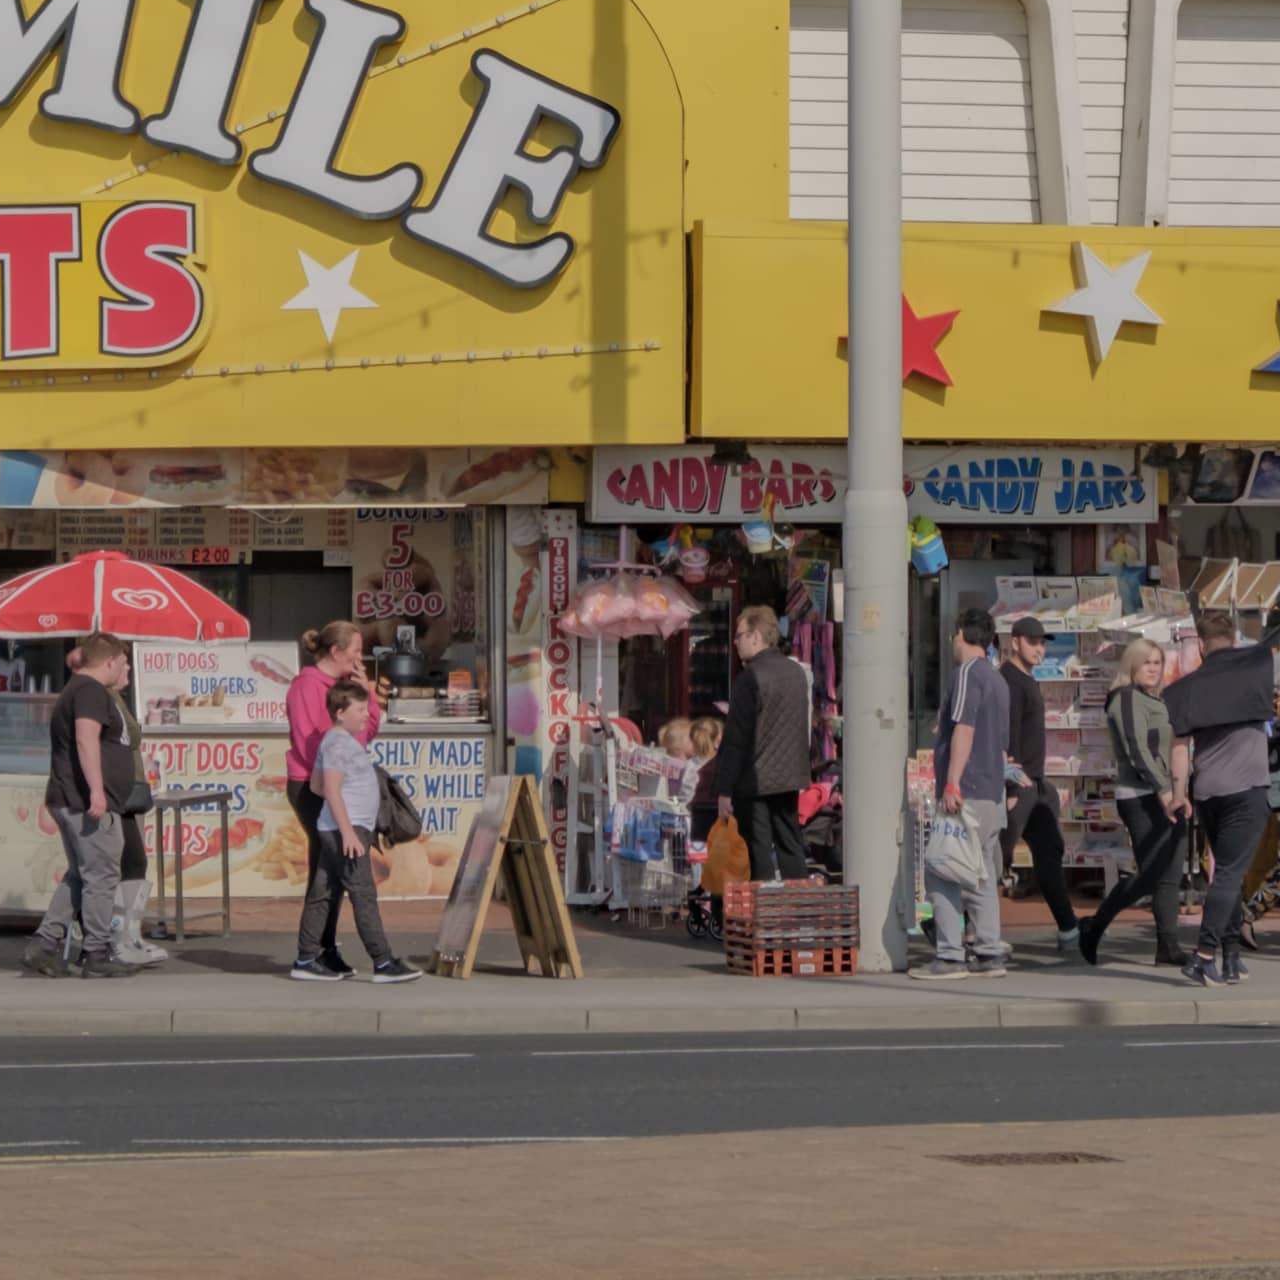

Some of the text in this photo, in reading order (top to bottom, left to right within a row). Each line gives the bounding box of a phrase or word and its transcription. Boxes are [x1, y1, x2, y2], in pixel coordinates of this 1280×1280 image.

[606, 457, 837, 514] CANDY BARS
[923, 457, 1146, 515] CANDY JARS
[132, 547, 185, 561] DRINKS
[384, 523, 415, 568] 5
[384, 570, 416, 591] FOR
[356, 592, 445, 618] £3.00
[143, 652, 218, 671] HOT DOGS
[196, 741, 261, 773] DOGS
[367, 740, 484, 767] SHLY MADE
[423, 773, 484, 799] WHILE
